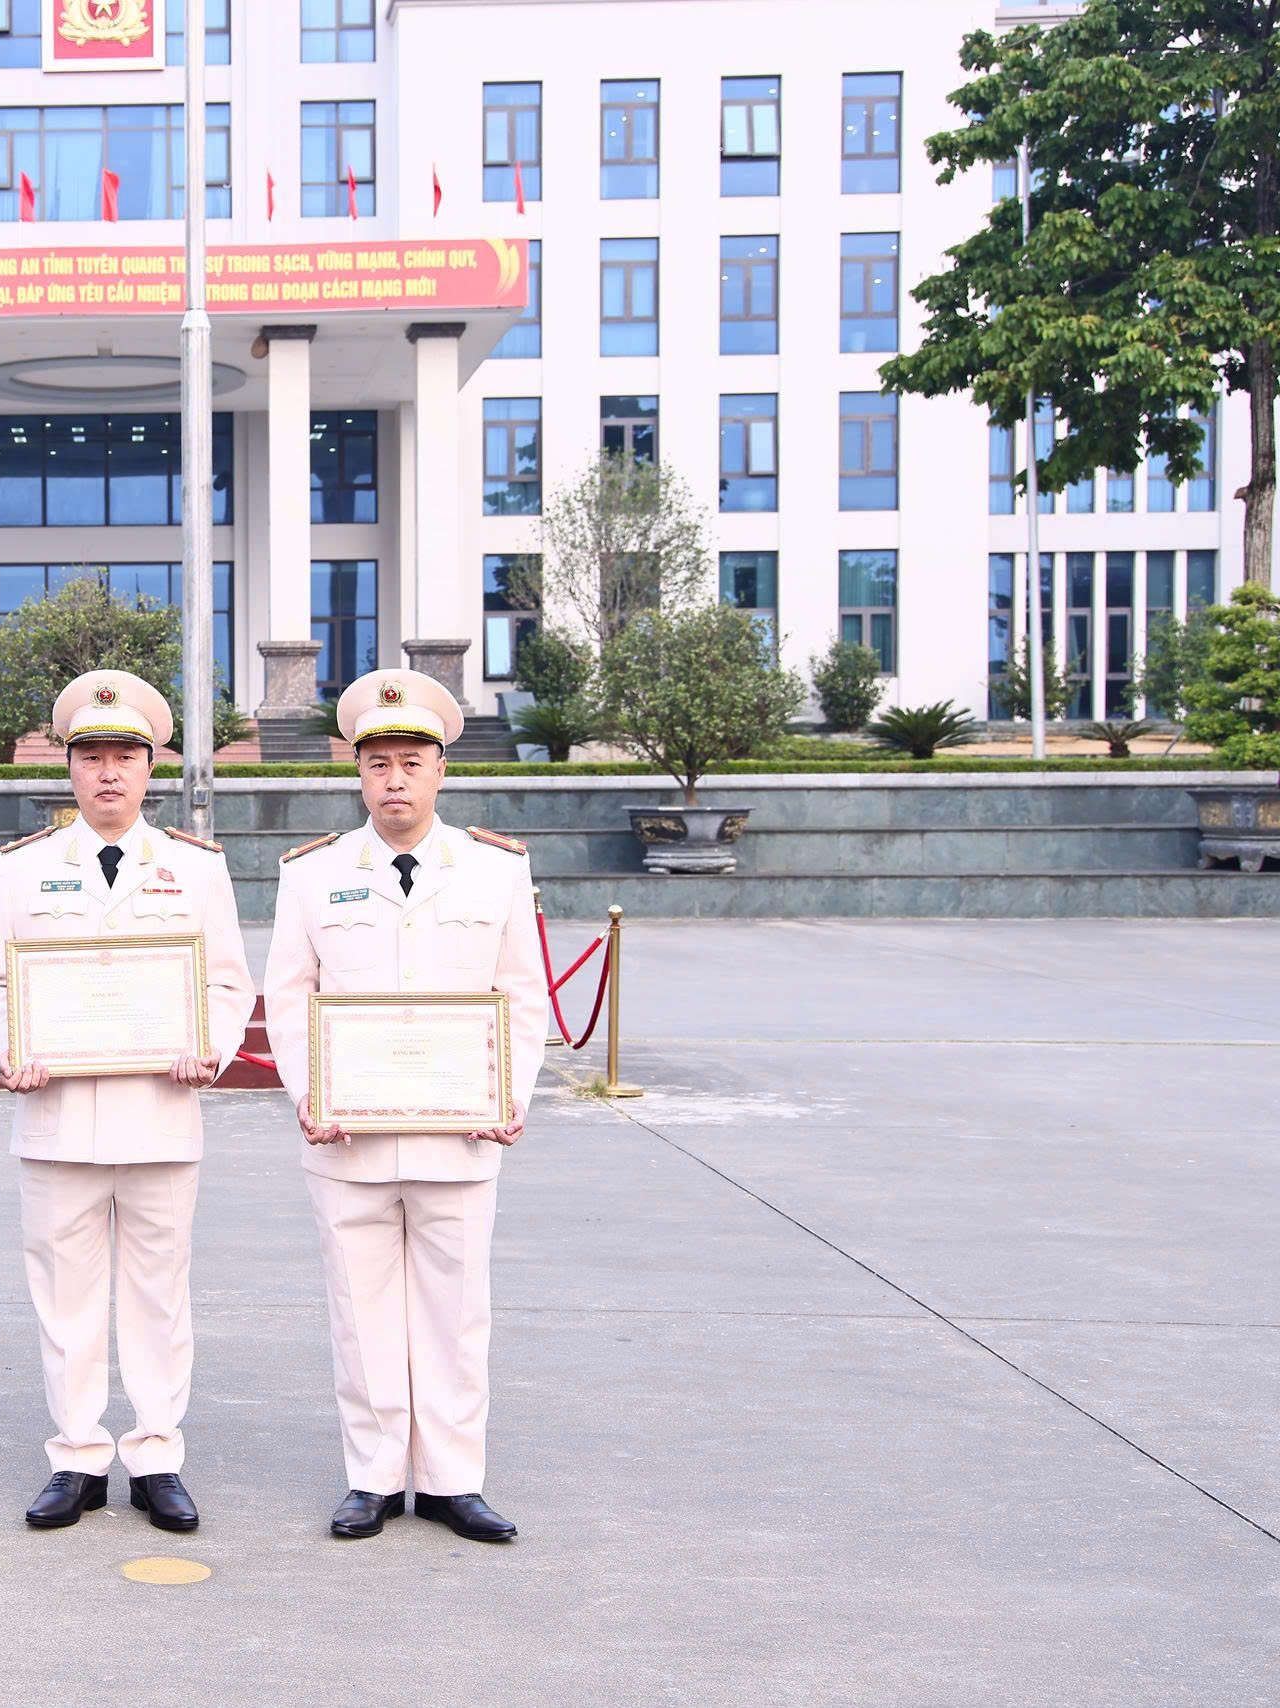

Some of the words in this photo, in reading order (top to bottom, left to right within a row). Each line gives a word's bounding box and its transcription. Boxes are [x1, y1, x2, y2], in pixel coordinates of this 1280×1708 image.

[21, 257, 40, 275] AN
[43, 252, 74, 275] TỈNH
[76, 253, 118, 274] TUYÊN
[122, 255, 166, 276] QUANG
[226, 255, 271, 273] TRONG
[274, 254, 314, 276] SẠCH,
[316, 249, 353, 270] VỮNG
[356, 251, 401, 272] MẠNH,
[404, 247, 445, 268] CHÍNH
[449, 249, 478, 270] QUY,
[17, 282, 45, 304] ĐÁP
[48, 282, 76, 303] ỨNG
[78, 281, 104, 302] YÊU
[137, 281, 182, 306] NHIỆM
[206, 283, 248, 301] TRONG
[252, 283, 279, 301] GIAI
[282, 282, 319, 304] ĐOẠN
[322, 277, 358, 299] CÁCH
[361, 279, 402, 301] MẠNG
[406, 275, 437, 296] MỚI!
